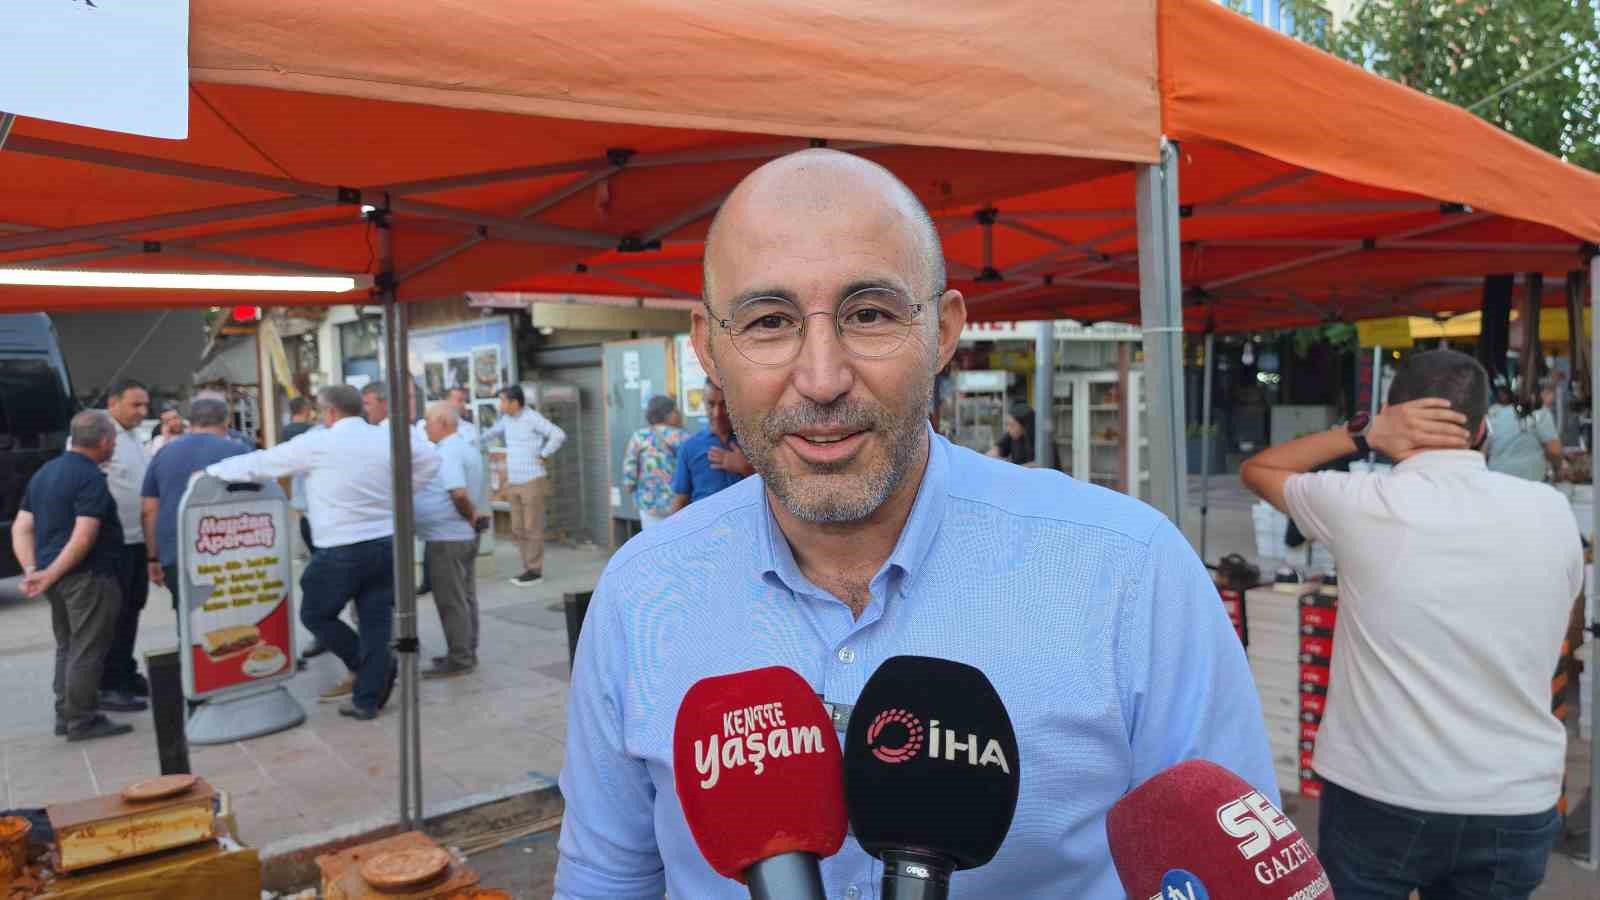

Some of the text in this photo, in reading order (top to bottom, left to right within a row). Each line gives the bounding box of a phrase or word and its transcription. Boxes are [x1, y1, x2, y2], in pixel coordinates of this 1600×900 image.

[723, 702, 786, 738] KENTTE
[928, 719, 1010, 775] İHA
[694, 725, 825, 789] yaşam
